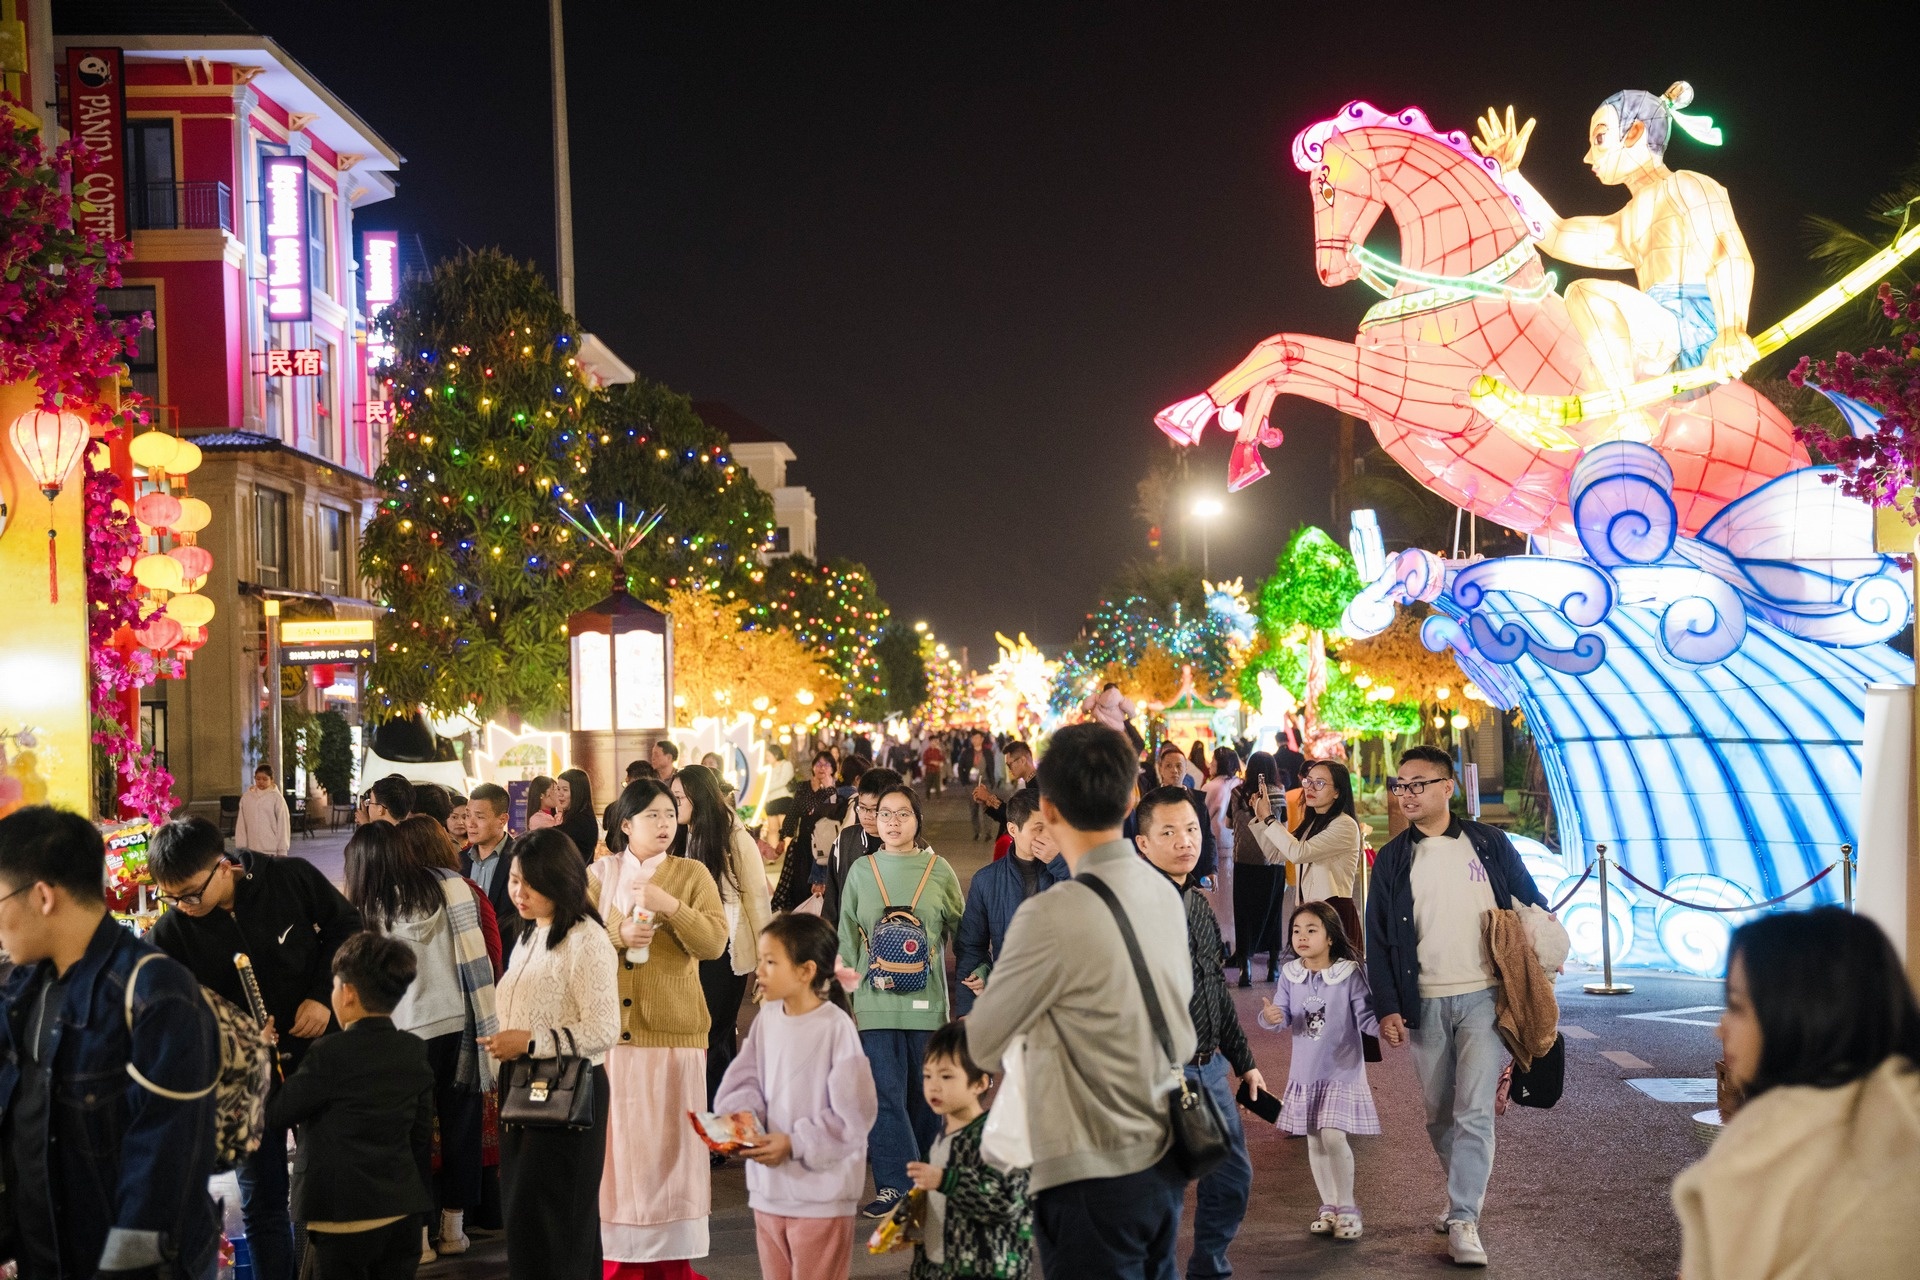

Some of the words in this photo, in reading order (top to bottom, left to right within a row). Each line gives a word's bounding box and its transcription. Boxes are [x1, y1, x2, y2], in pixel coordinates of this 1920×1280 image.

[83, 173, 116, 242] COFFE
[268, 349, 320, 376] 民宿
[110, 834, 147, 849] POCA
[1468, 859, 1486, 882] NY
